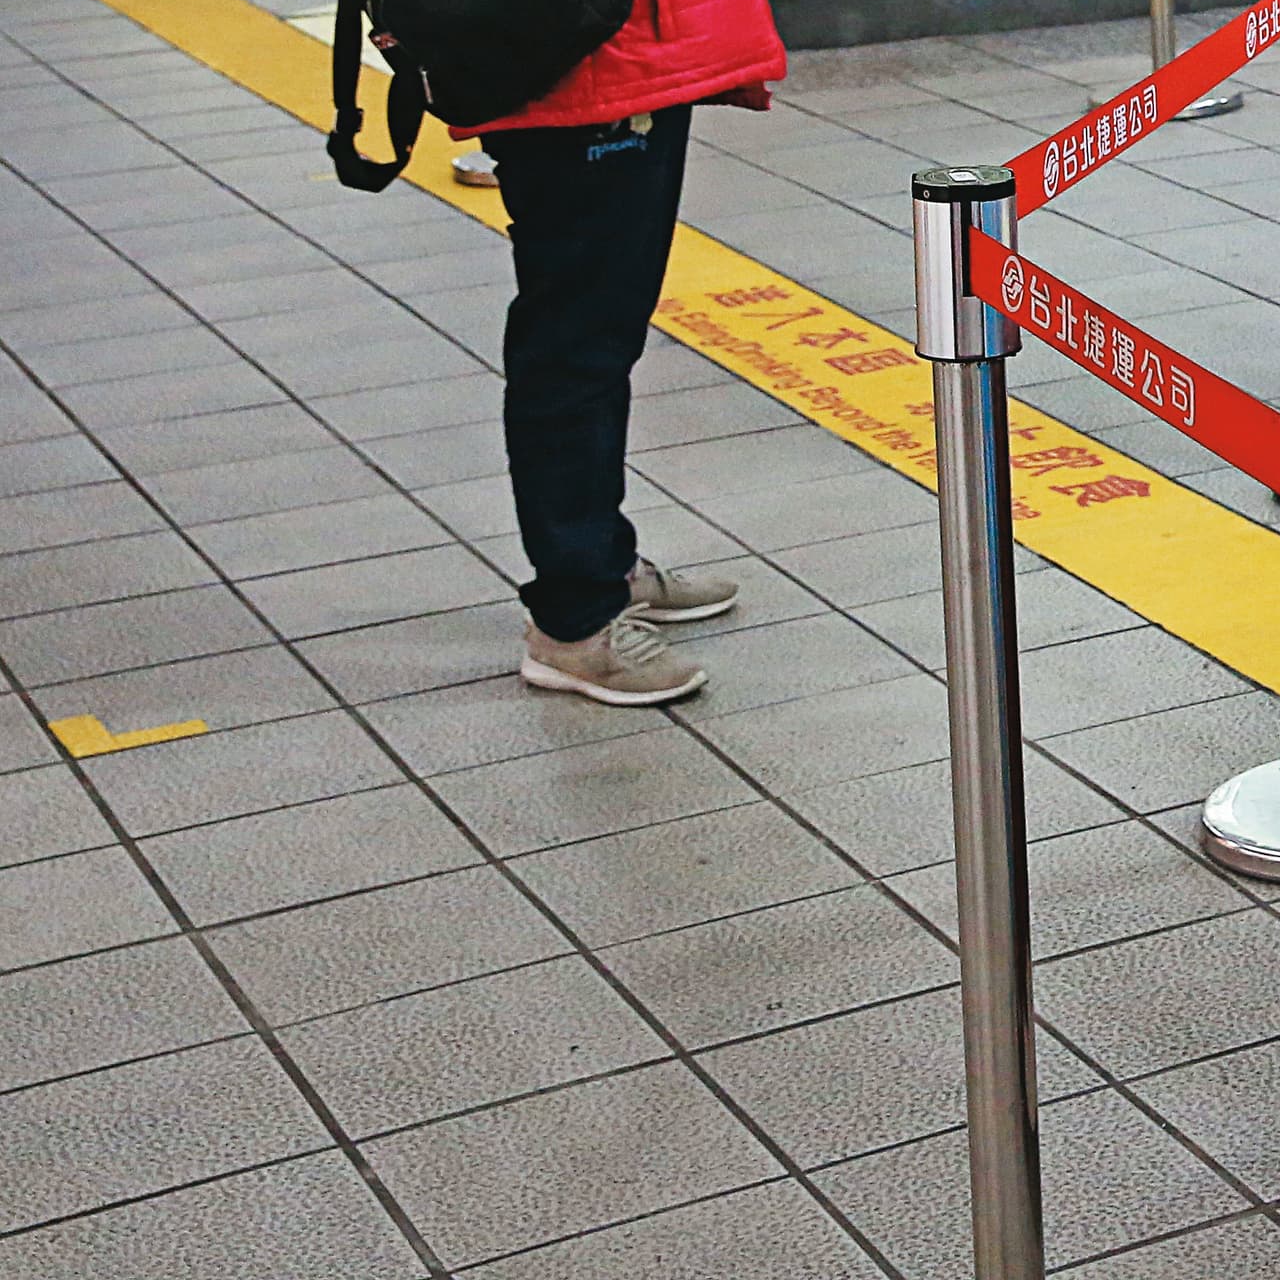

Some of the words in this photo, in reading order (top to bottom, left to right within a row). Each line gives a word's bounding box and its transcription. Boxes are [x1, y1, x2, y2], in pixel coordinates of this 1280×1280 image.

[1062, 82, 1159, 183] 台北捷運公司
[1029, 274, 1195, 428] 台北捷運公司
